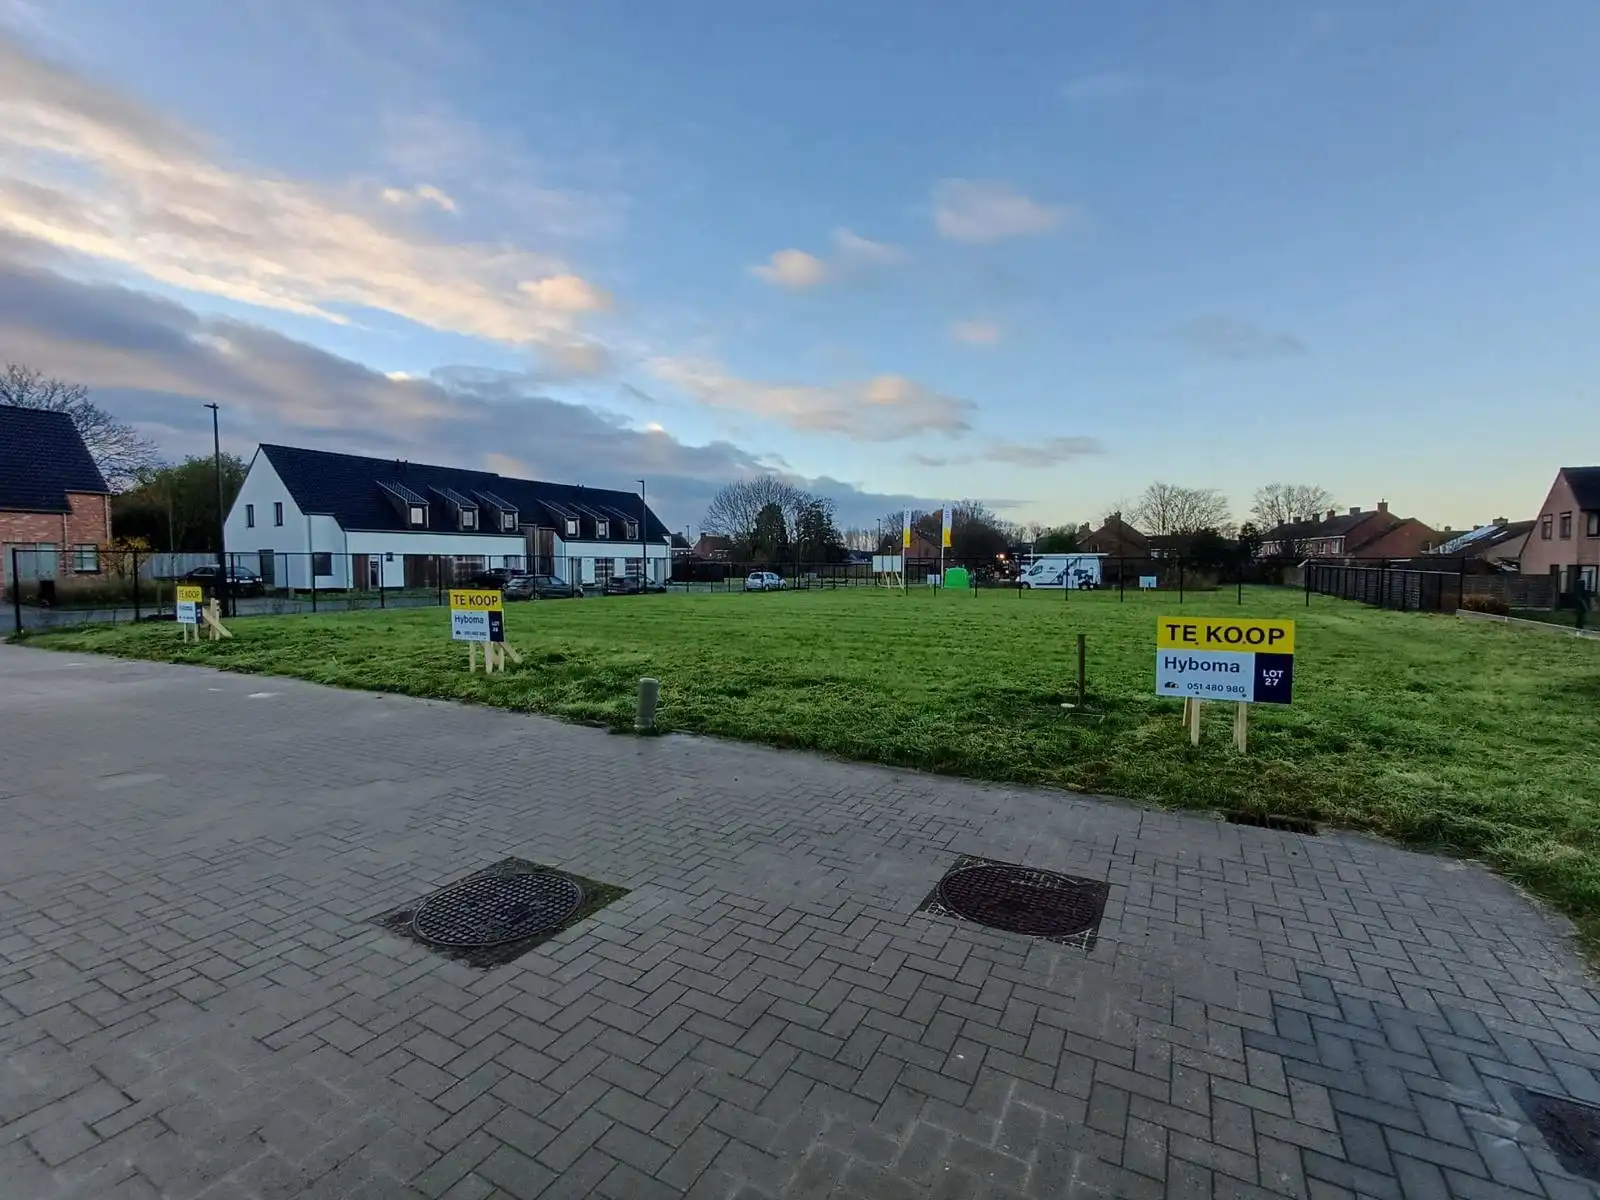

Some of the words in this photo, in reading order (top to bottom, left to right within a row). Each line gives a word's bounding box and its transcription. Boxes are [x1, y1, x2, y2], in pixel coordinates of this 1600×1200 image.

[453, 594, 466, 605] TE
[469, 595, 498, 606] KOOP
[454, 614, 485, 625] Hyboma
[1166, 624, 1197, 642] TE
[1206, 625, 1285, 645] KOOP
[1164, 656, 1240, 674] Hyboma
[1263, 669, 1284, 678] LOT
[1187, 682, 1202, 690] 051
[1205, 683, 1224, 692] 480
[1226, 685, 1245, 693] 980
[1264, 678, 1279, 686] 27
